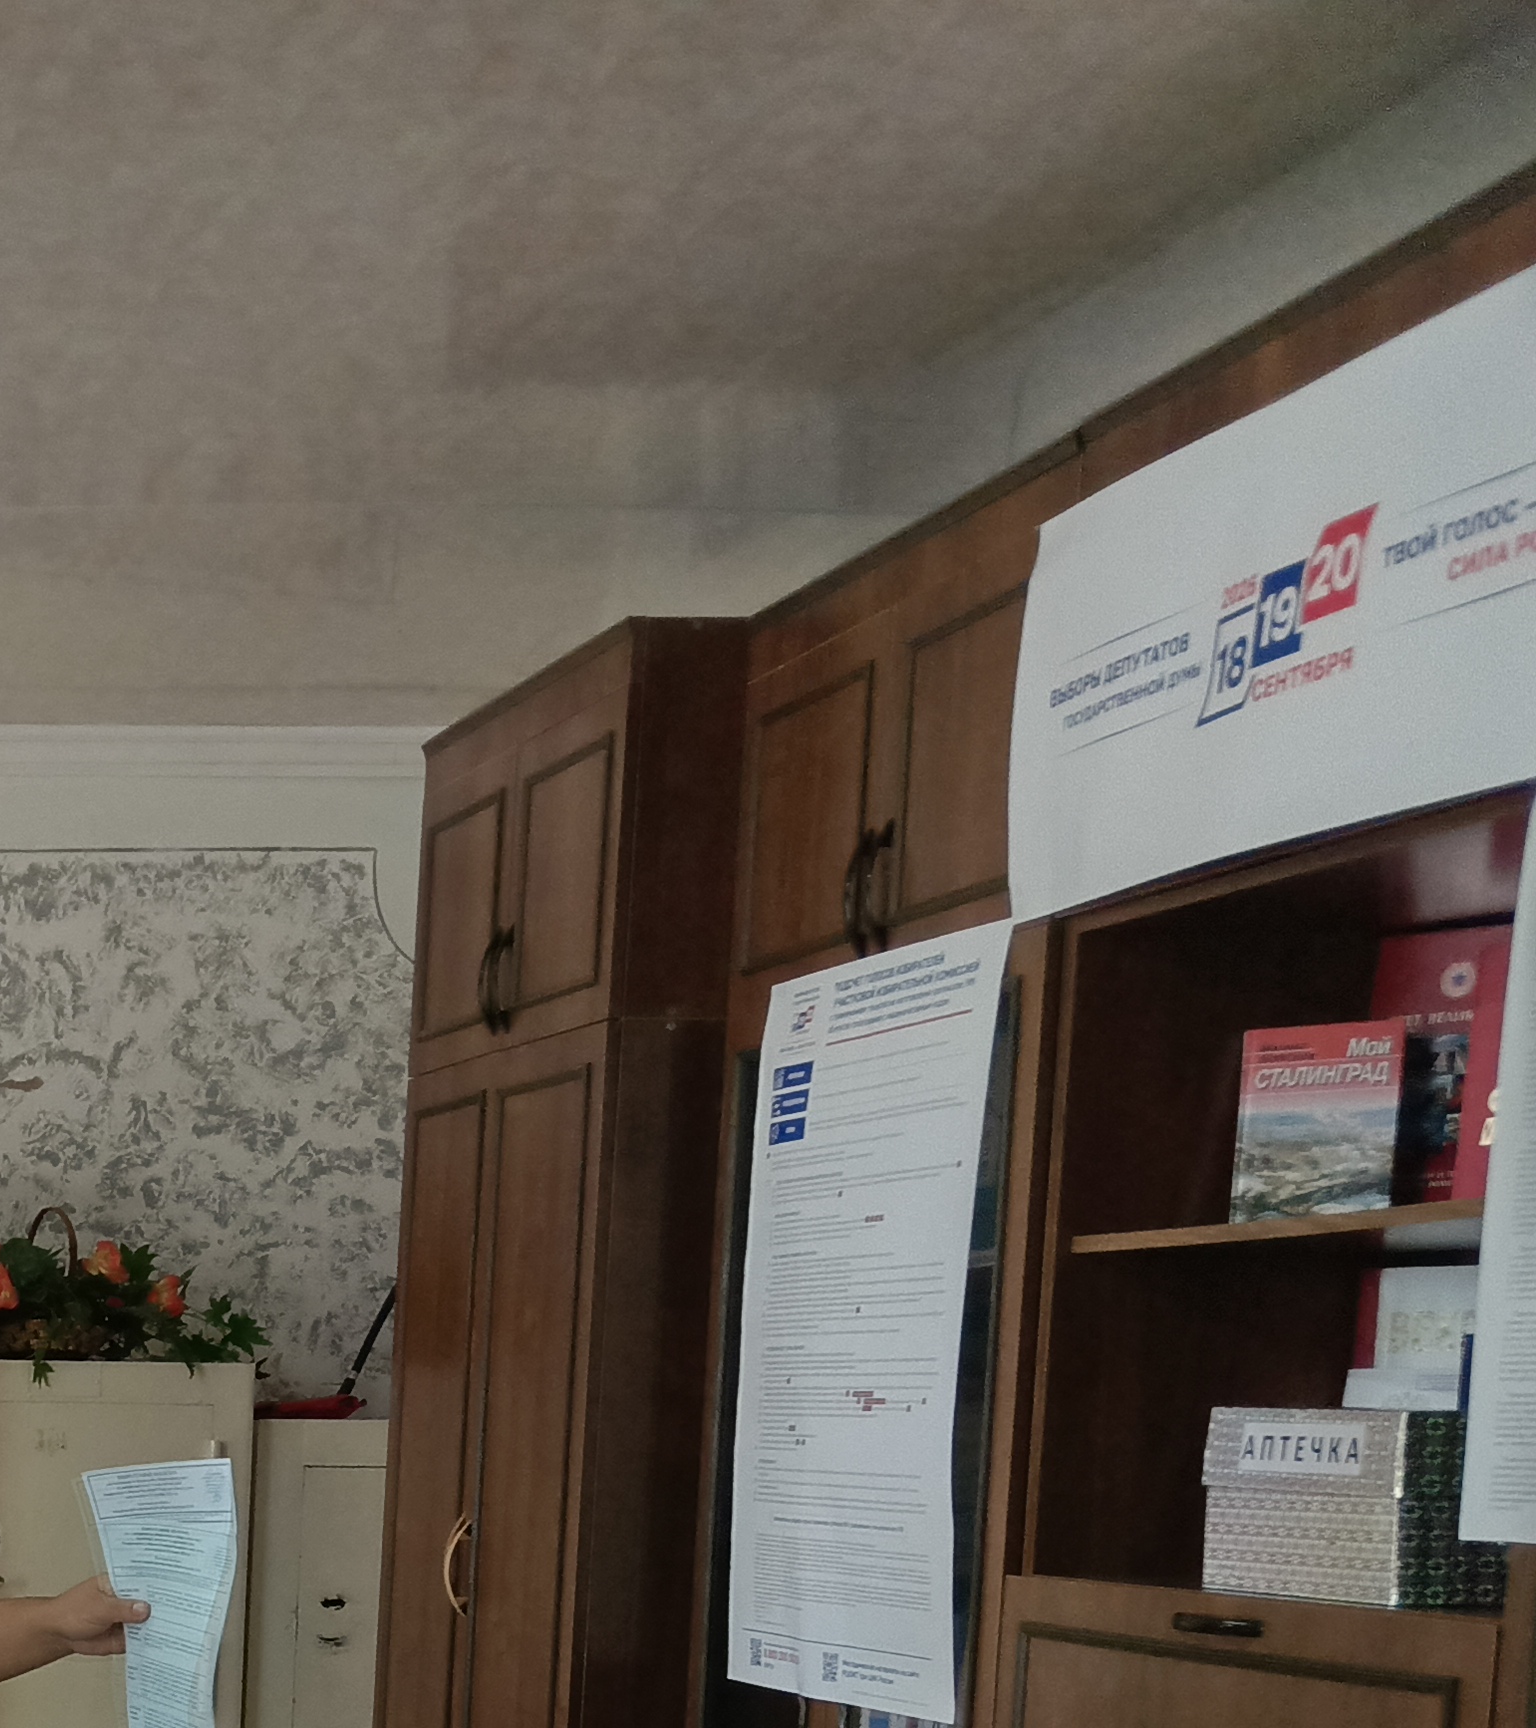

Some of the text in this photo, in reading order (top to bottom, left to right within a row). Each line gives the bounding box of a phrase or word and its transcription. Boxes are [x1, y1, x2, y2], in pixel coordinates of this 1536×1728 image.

[1383, 523, 1438, 568] ТВОЙ
[1441, 498, 1519, 547] ГОЛОС
[1308, 533, 1360, 602] 20
[1259, 586, 1299, 649] 19
[1103, 632, 1191, 685] ДЕПУТАТОВ
[1216, 635, 1248, 694] 18
[1250, 646, 1355, 702] СЕНТЯБРЯ
[1346, 1036, 1392, 1057] Мой
[1255, 1061, 1390, 1089] СТАЛИНГРАД
[1240, 1435, 1359, 1464] АПТЕЧКА
